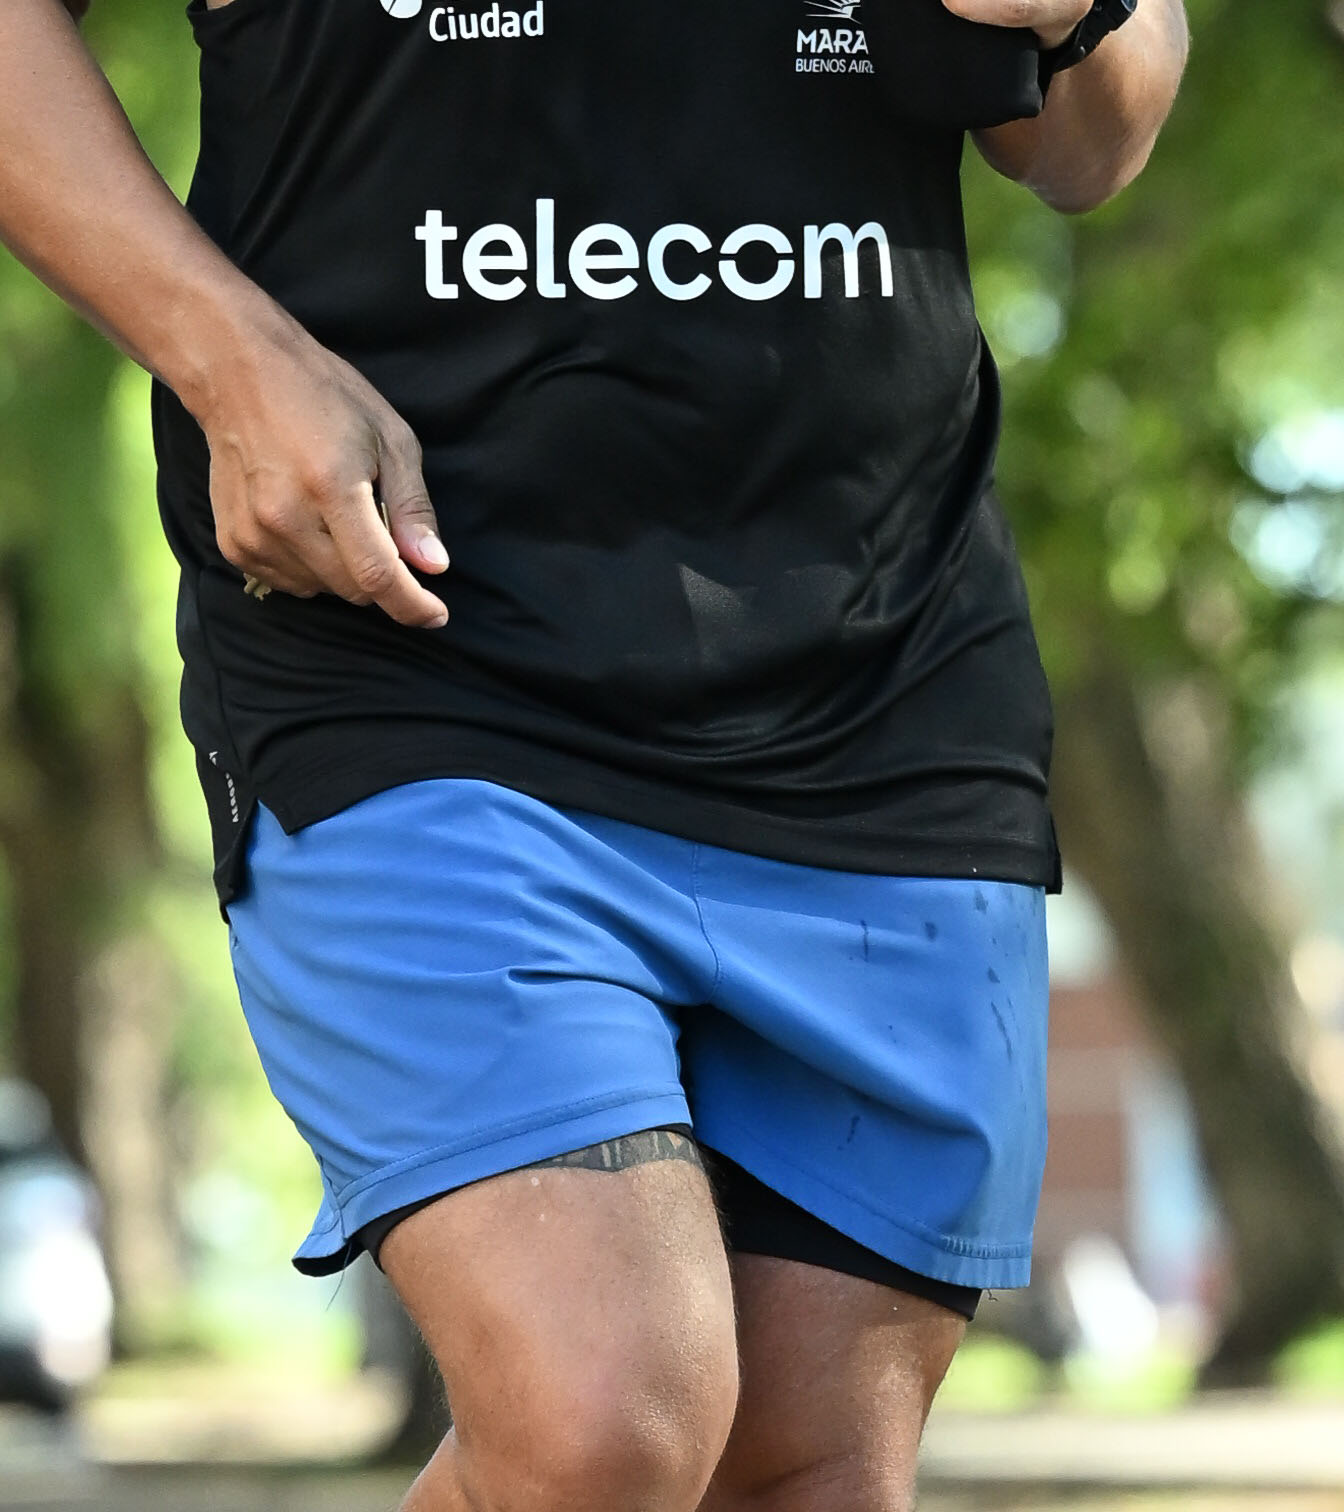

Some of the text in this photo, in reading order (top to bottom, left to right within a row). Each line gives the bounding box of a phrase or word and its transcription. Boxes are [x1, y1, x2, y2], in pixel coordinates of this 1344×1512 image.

[429, 0, 544, 42] Ciudad
[795, 58, 846, 73] BUENOS
[414, 198, 894, 301] telecom
